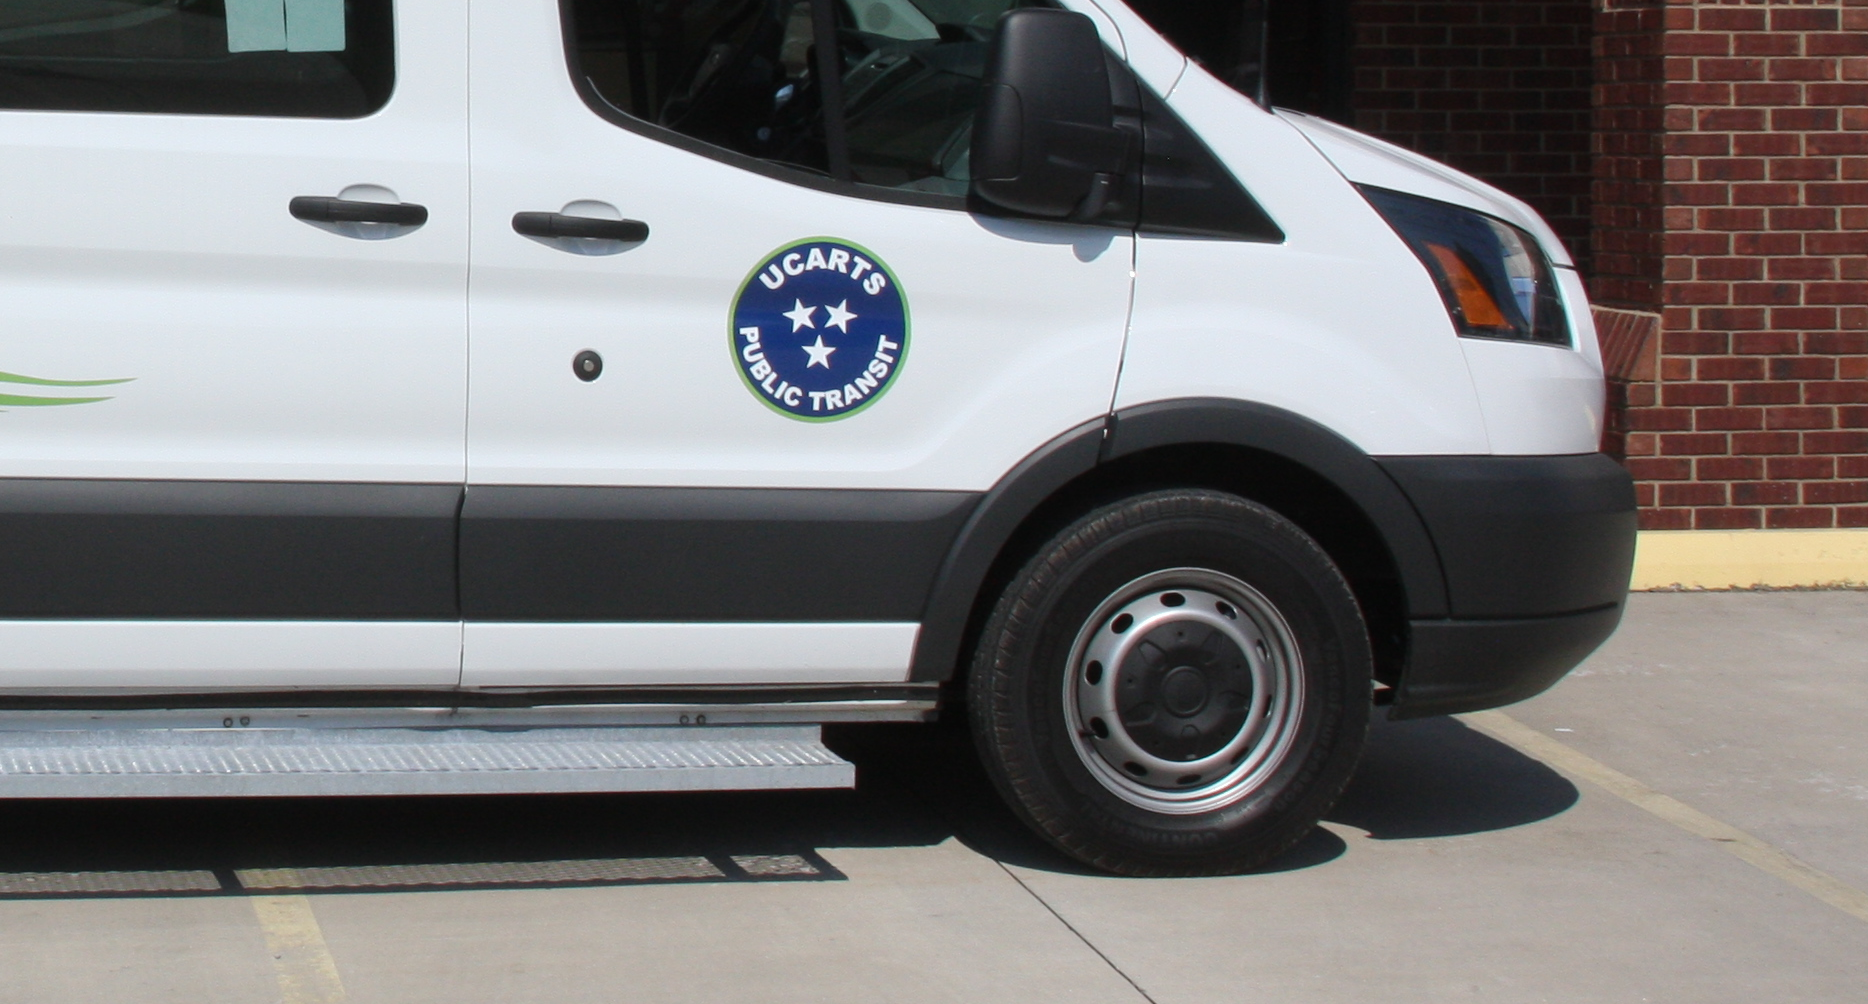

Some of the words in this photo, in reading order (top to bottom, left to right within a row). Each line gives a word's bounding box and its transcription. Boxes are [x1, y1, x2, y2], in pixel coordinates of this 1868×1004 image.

[758, 248, 886, 295] UCARTS
[739, 326, 802, 407] PUBLIC
[808, 334, 898, 411] TRANSIT
